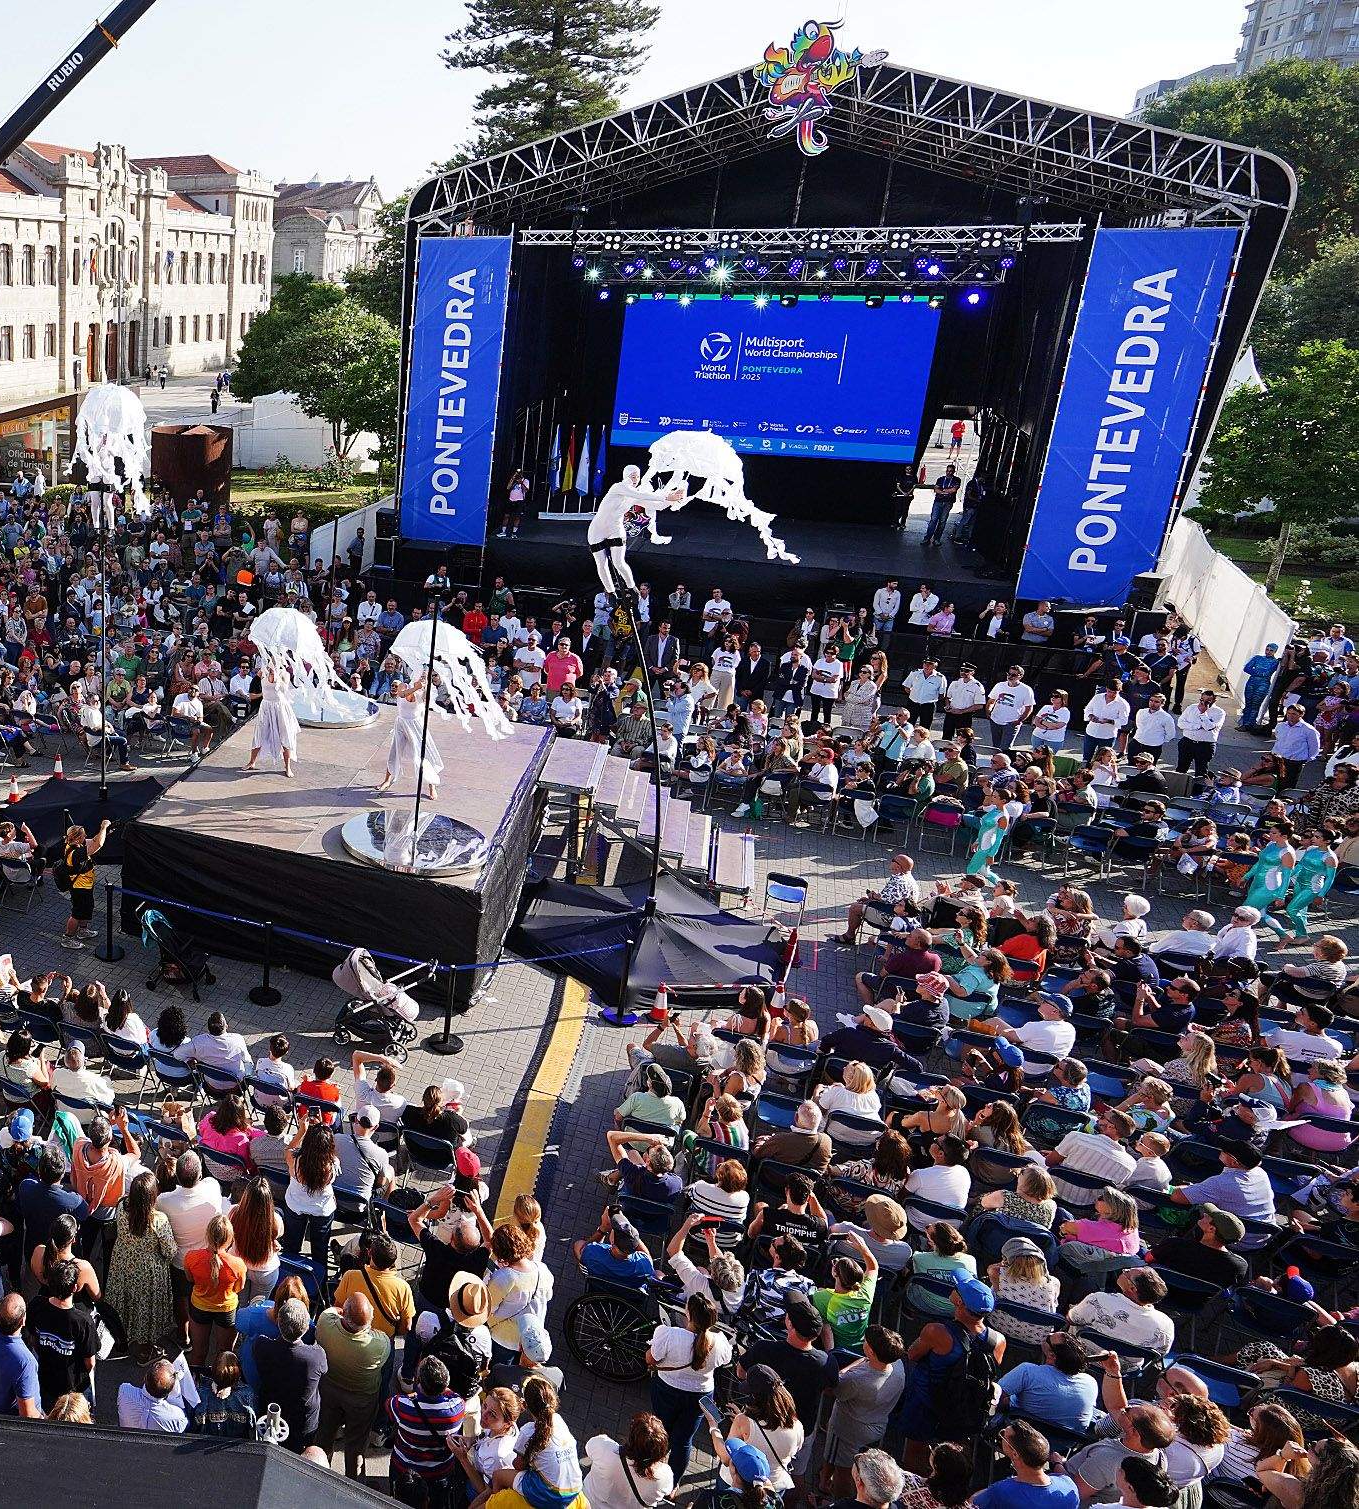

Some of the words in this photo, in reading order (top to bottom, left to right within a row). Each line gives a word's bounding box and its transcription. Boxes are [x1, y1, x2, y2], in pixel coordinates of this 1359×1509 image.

[46, 52, 84, 92] RUBIO
[745, 336, 804, 349] Multisport
[744, 348, 771, 358] World
[772, 349, 838, 361] Championships
[700, 364, 727, 373] World
[742, 365, 803, 375] PONTEVEDRA
[694, 371, 731, 381] Triathlon
[741, 373, 761, 381] 2025
[429, 268, 477, 517] PONTEVEDRA
[1068, 268, 1178, 573] PONTEVEDRA
[8, 449, 36, 460] Oficina
[8, 459, 19, 468] de
[21, 459, 51, 470] Turismo
[775, 1223, 817, 1238] TRIOMPHE
[837, 1312, 868, 1325] AUS
